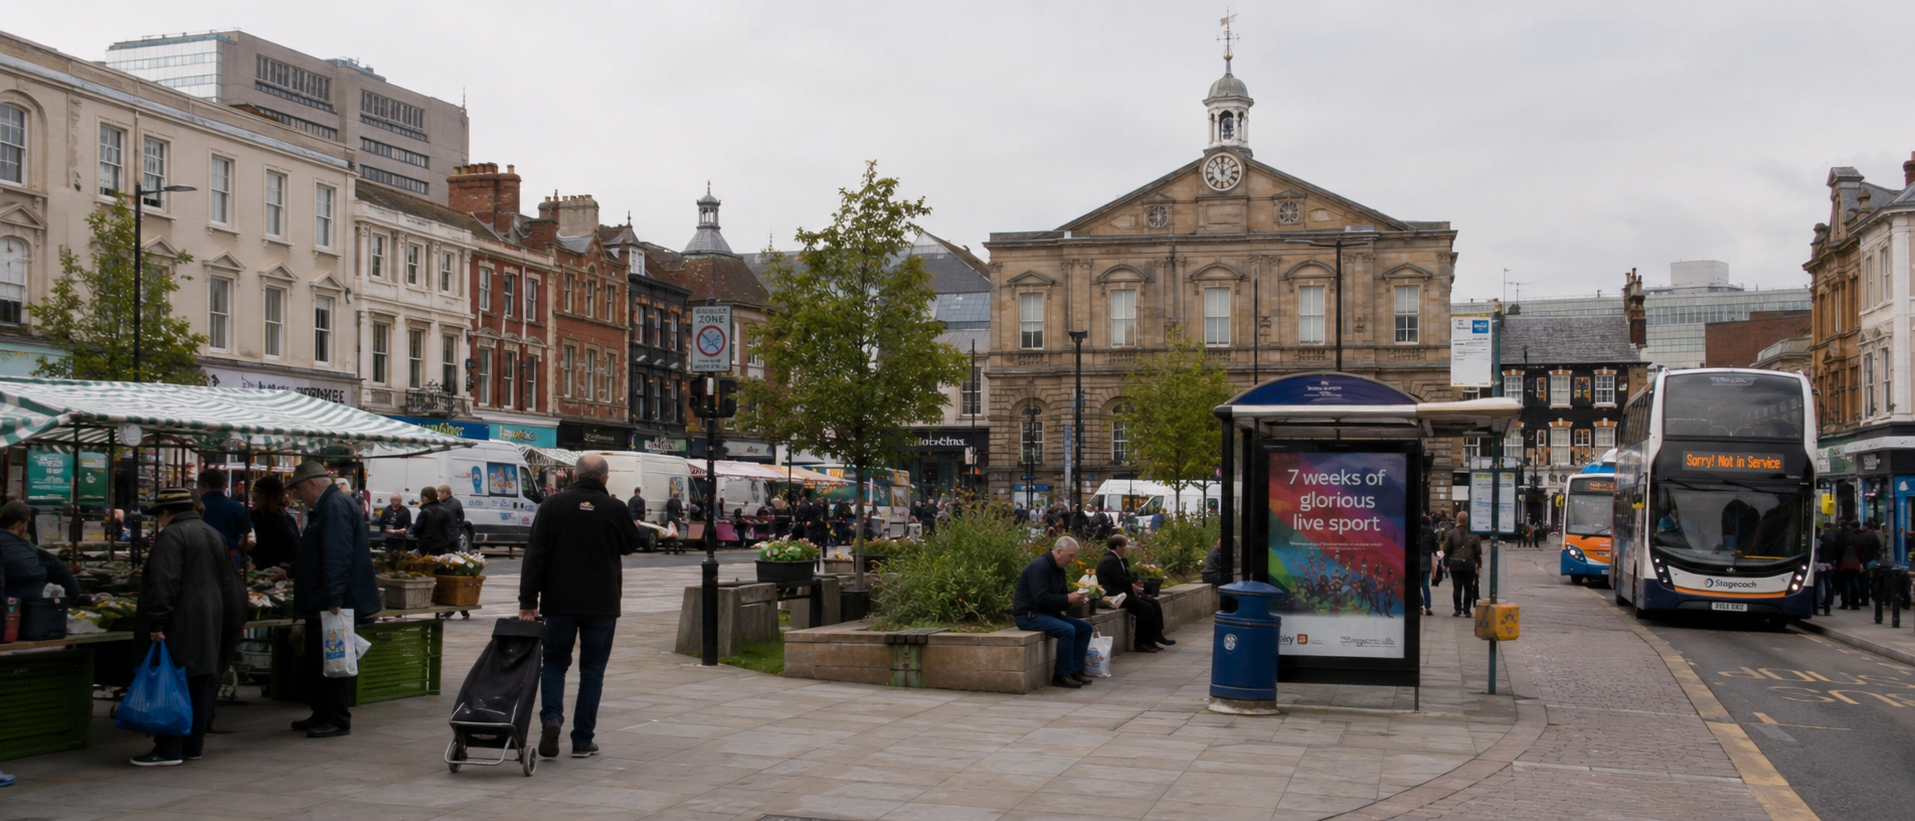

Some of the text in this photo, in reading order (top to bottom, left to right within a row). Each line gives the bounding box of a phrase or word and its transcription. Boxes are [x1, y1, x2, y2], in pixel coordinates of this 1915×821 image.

[698, 315, 725, 324] ZONE
[1686, 453, 1715, 469] Sorry!
[1718, 454, 1734, 468] Not
[1736, 455, 1745, 468] in
[1287, 469, 1387, 486] 7 weeks of
[1300, 491, 1376, 512] glorious
[1293, 513, 1381, 535] live sport
